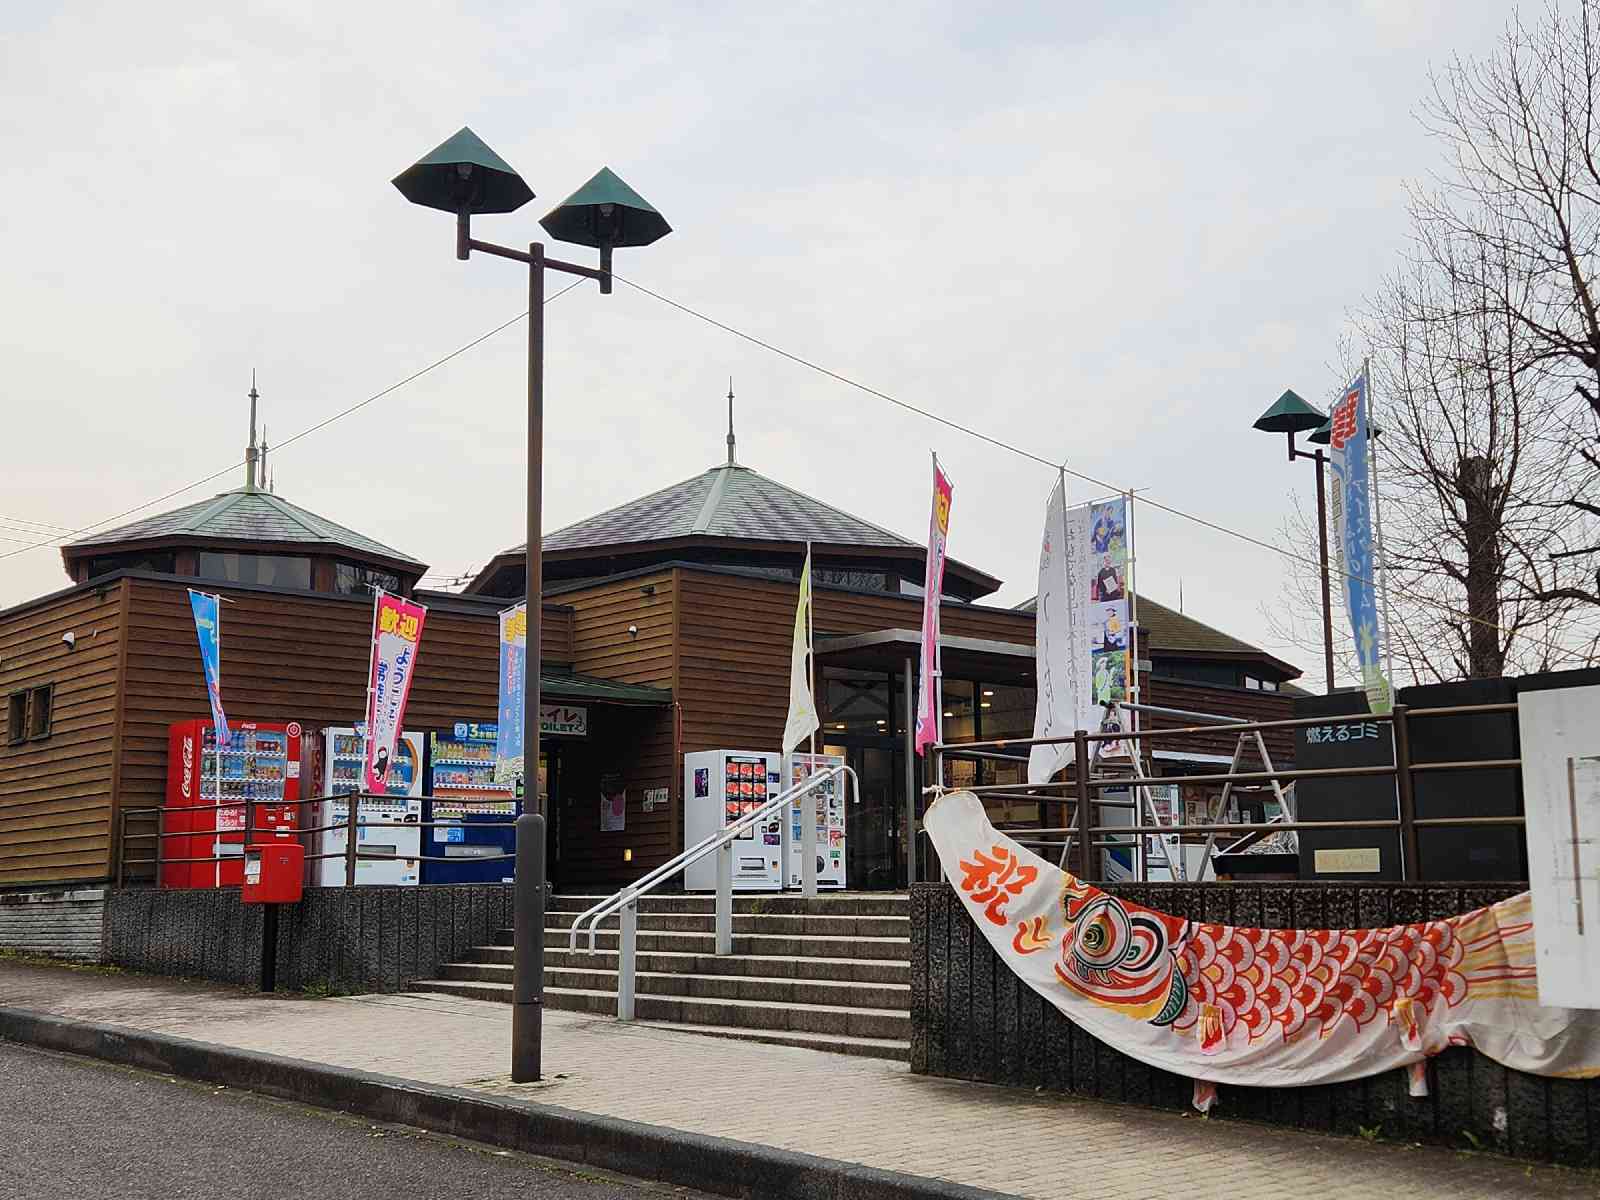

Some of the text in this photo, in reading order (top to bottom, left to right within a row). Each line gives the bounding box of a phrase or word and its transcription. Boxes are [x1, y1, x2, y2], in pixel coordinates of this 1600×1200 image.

[540, 708, 577, 722] イレ
[541, 722, 576, 732] OILET
[1306, 722, 1378, 744] 燃えるゴミ
